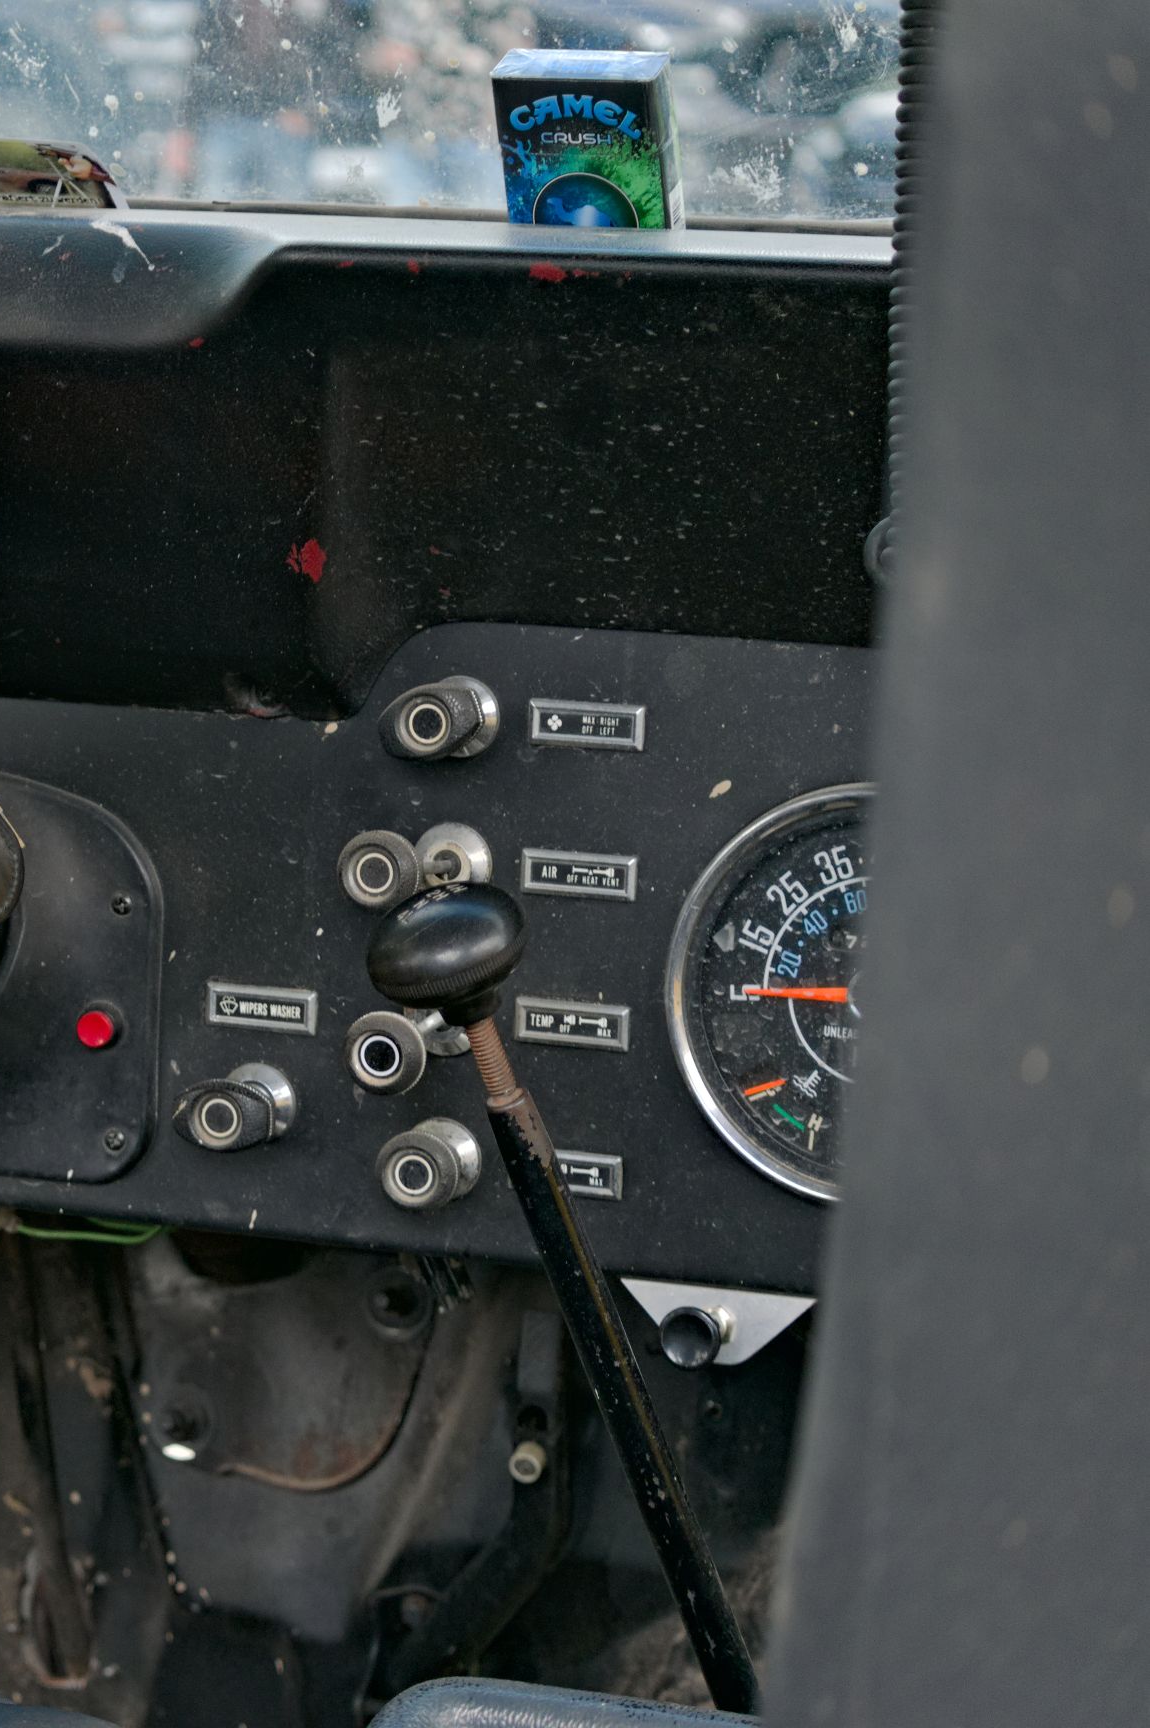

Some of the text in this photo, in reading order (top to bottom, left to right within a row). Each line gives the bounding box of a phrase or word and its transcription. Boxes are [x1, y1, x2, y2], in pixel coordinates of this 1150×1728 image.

[510, 94, 642, 140] CAMEL
[540, 132, 612, 145] CRUSH
[582, 715, 619, 727] MAX RIGHT
[581, 726, 615, 736] OFF LEFT
[541, 865, 558, 879] AIR
[813, 845, 855, 885] 35
[566, 874, 620, 887] OFF HEAT VENT
[766, 870, 809, 916] 25
[844, 890, 867, 914] 60
[803, 910, 828, 936] 40
[738, 919, 775, 954] 15
[777, 951, 802, 978] 20
[730, 984, 761, 1001] 5
[239, 1001, 301, 1019] WIPERS WASHER
[530, 1013, 554, 1028] TEMP
[559, 1024, 570, 1034] OFF
[597, 1028, 611, 1038] MAX
[807, 1113, 823, 1132] H
[589, 1177, 603, 1187] MAX
